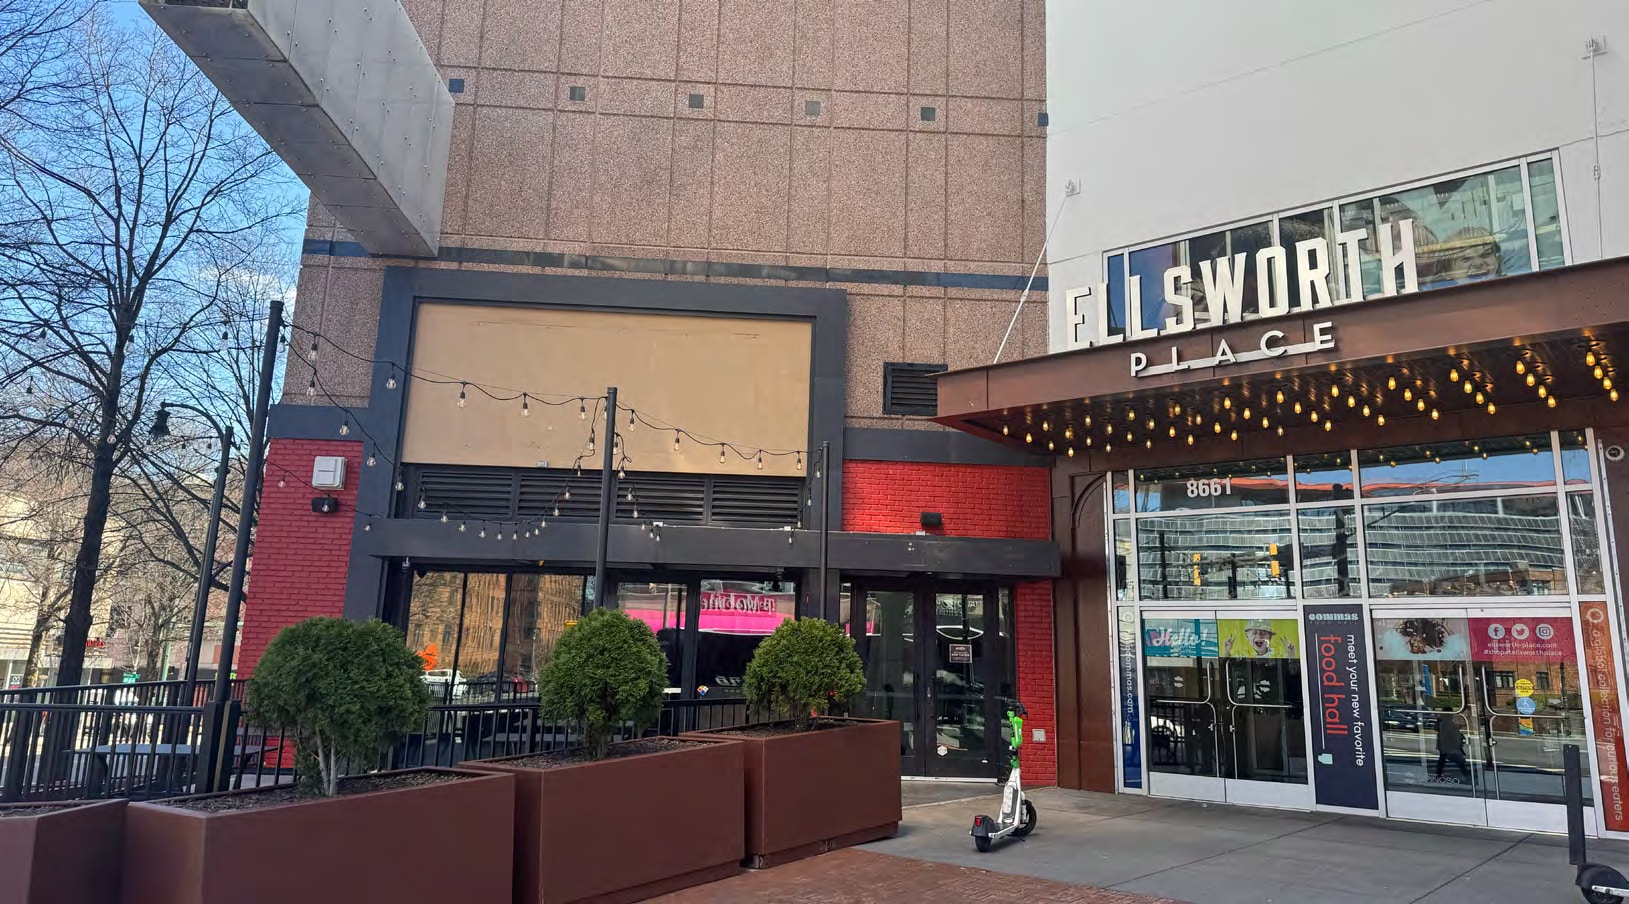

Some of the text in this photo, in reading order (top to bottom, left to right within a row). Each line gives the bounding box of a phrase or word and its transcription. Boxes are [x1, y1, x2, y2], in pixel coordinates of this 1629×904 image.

[1065, 217, 1420, 350] ELLSWORTH
[1130, 321, 1336, 377] PLACE
[1186, 478, 1232, 498] 8661
[1151, 626, 1208, 647] Hello!
[1308, 613, 1359, 621] commas
[1320, 634, 1349, 735] food hall
[1346, 634, 1366, 767] meet your new favorite
[1597, 674, 1613, 724] collection
[1611, 786, 1623, 820] eaters
